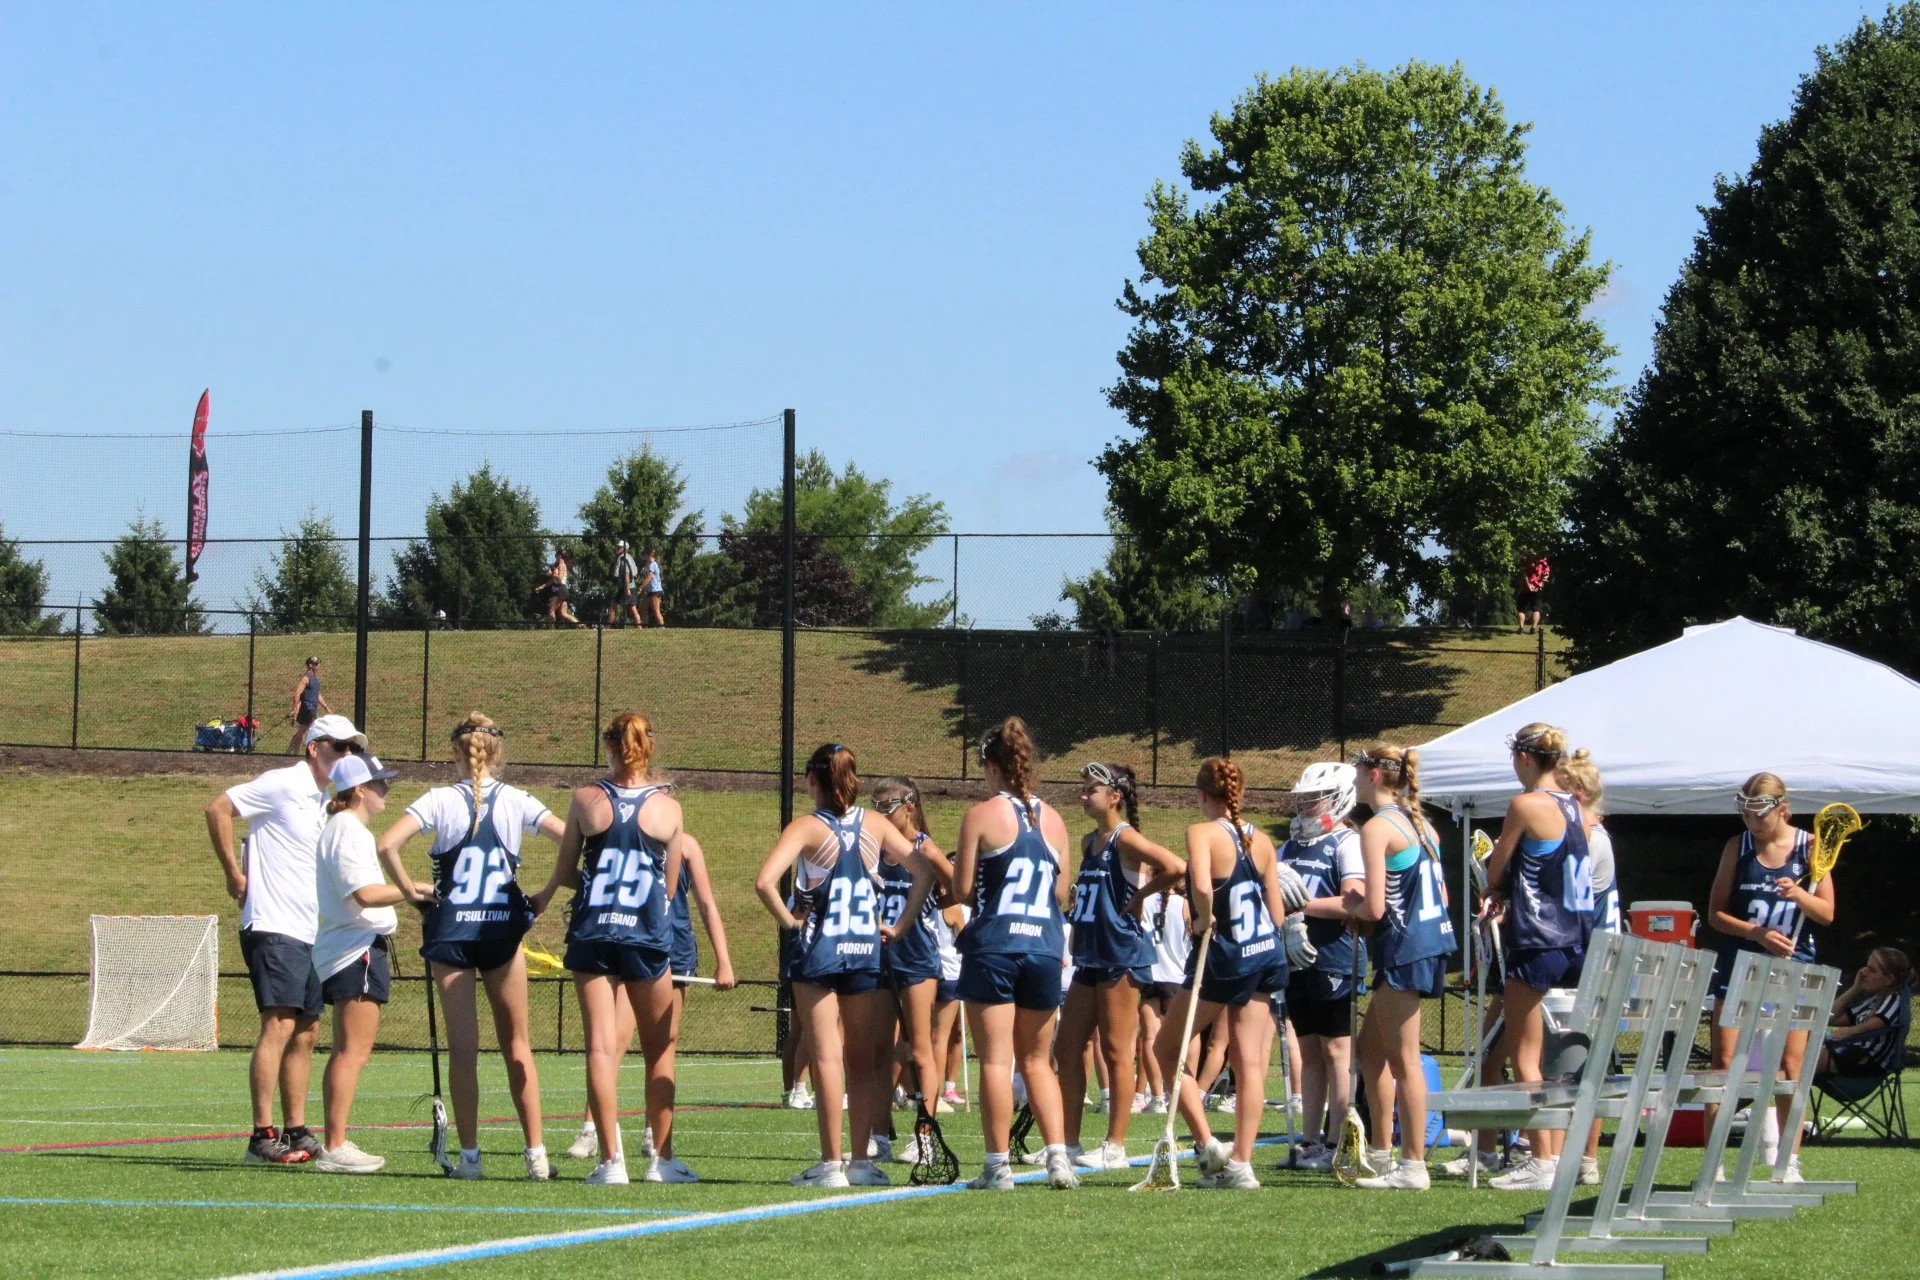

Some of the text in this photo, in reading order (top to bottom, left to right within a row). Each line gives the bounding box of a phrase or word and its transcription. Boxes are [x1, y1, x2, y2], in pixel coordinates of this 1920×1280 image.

[448, 845, 514, 905] 92
[588, 847, 654, 908] 25
[997, 857, 1054, 920] 21
[456, 909, 511, 923] O'SULLIVAN
[822, 876, 878, 937] 33
[877, 892, 907, 928] 3
[1229, 879, 1276, 944] 51
[1241, 937, 1276, 958] LEONARD
